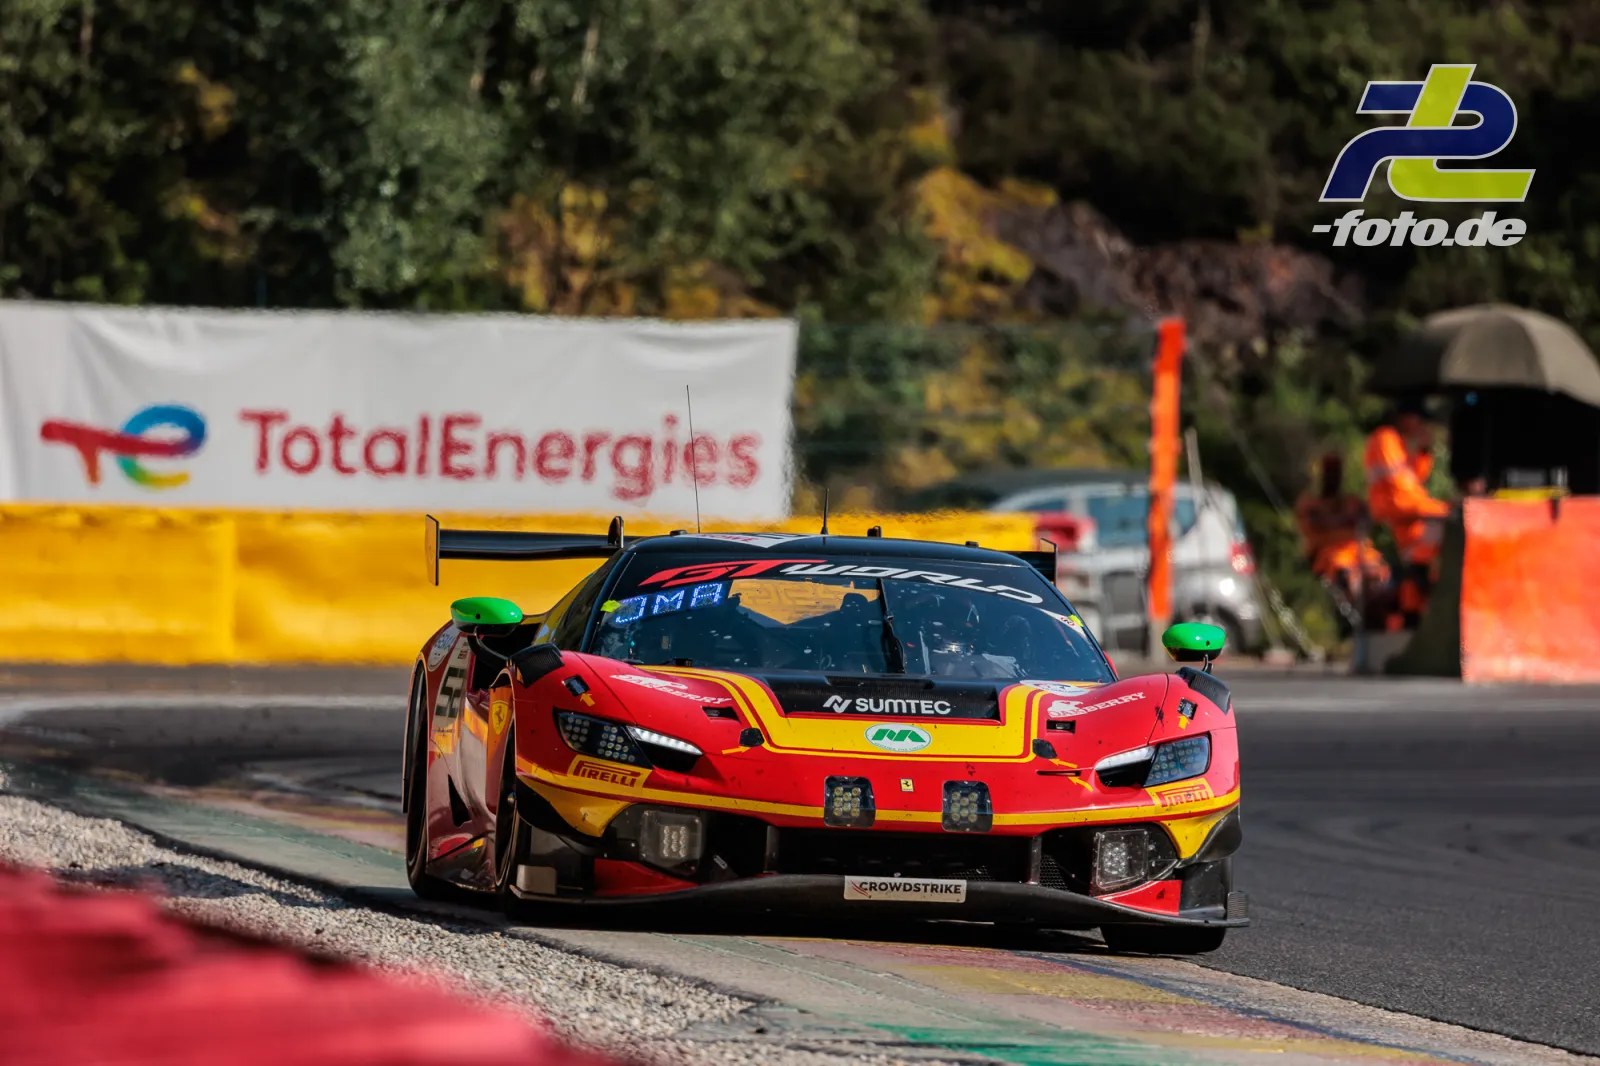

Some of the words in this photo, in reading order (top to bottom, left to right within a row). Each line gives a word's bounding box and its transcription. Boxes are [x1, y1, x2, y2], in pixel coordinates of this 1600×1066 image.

[239, 408, 762, 499] TotalEnergies
[855, 697, 952, 716] SUMTEC
[572, 759, 642, 788] PIRELLI
[1155, 783, 1210, 808] PIRELLI
[859, 881, 962, 895] CROWDSTRIKE
